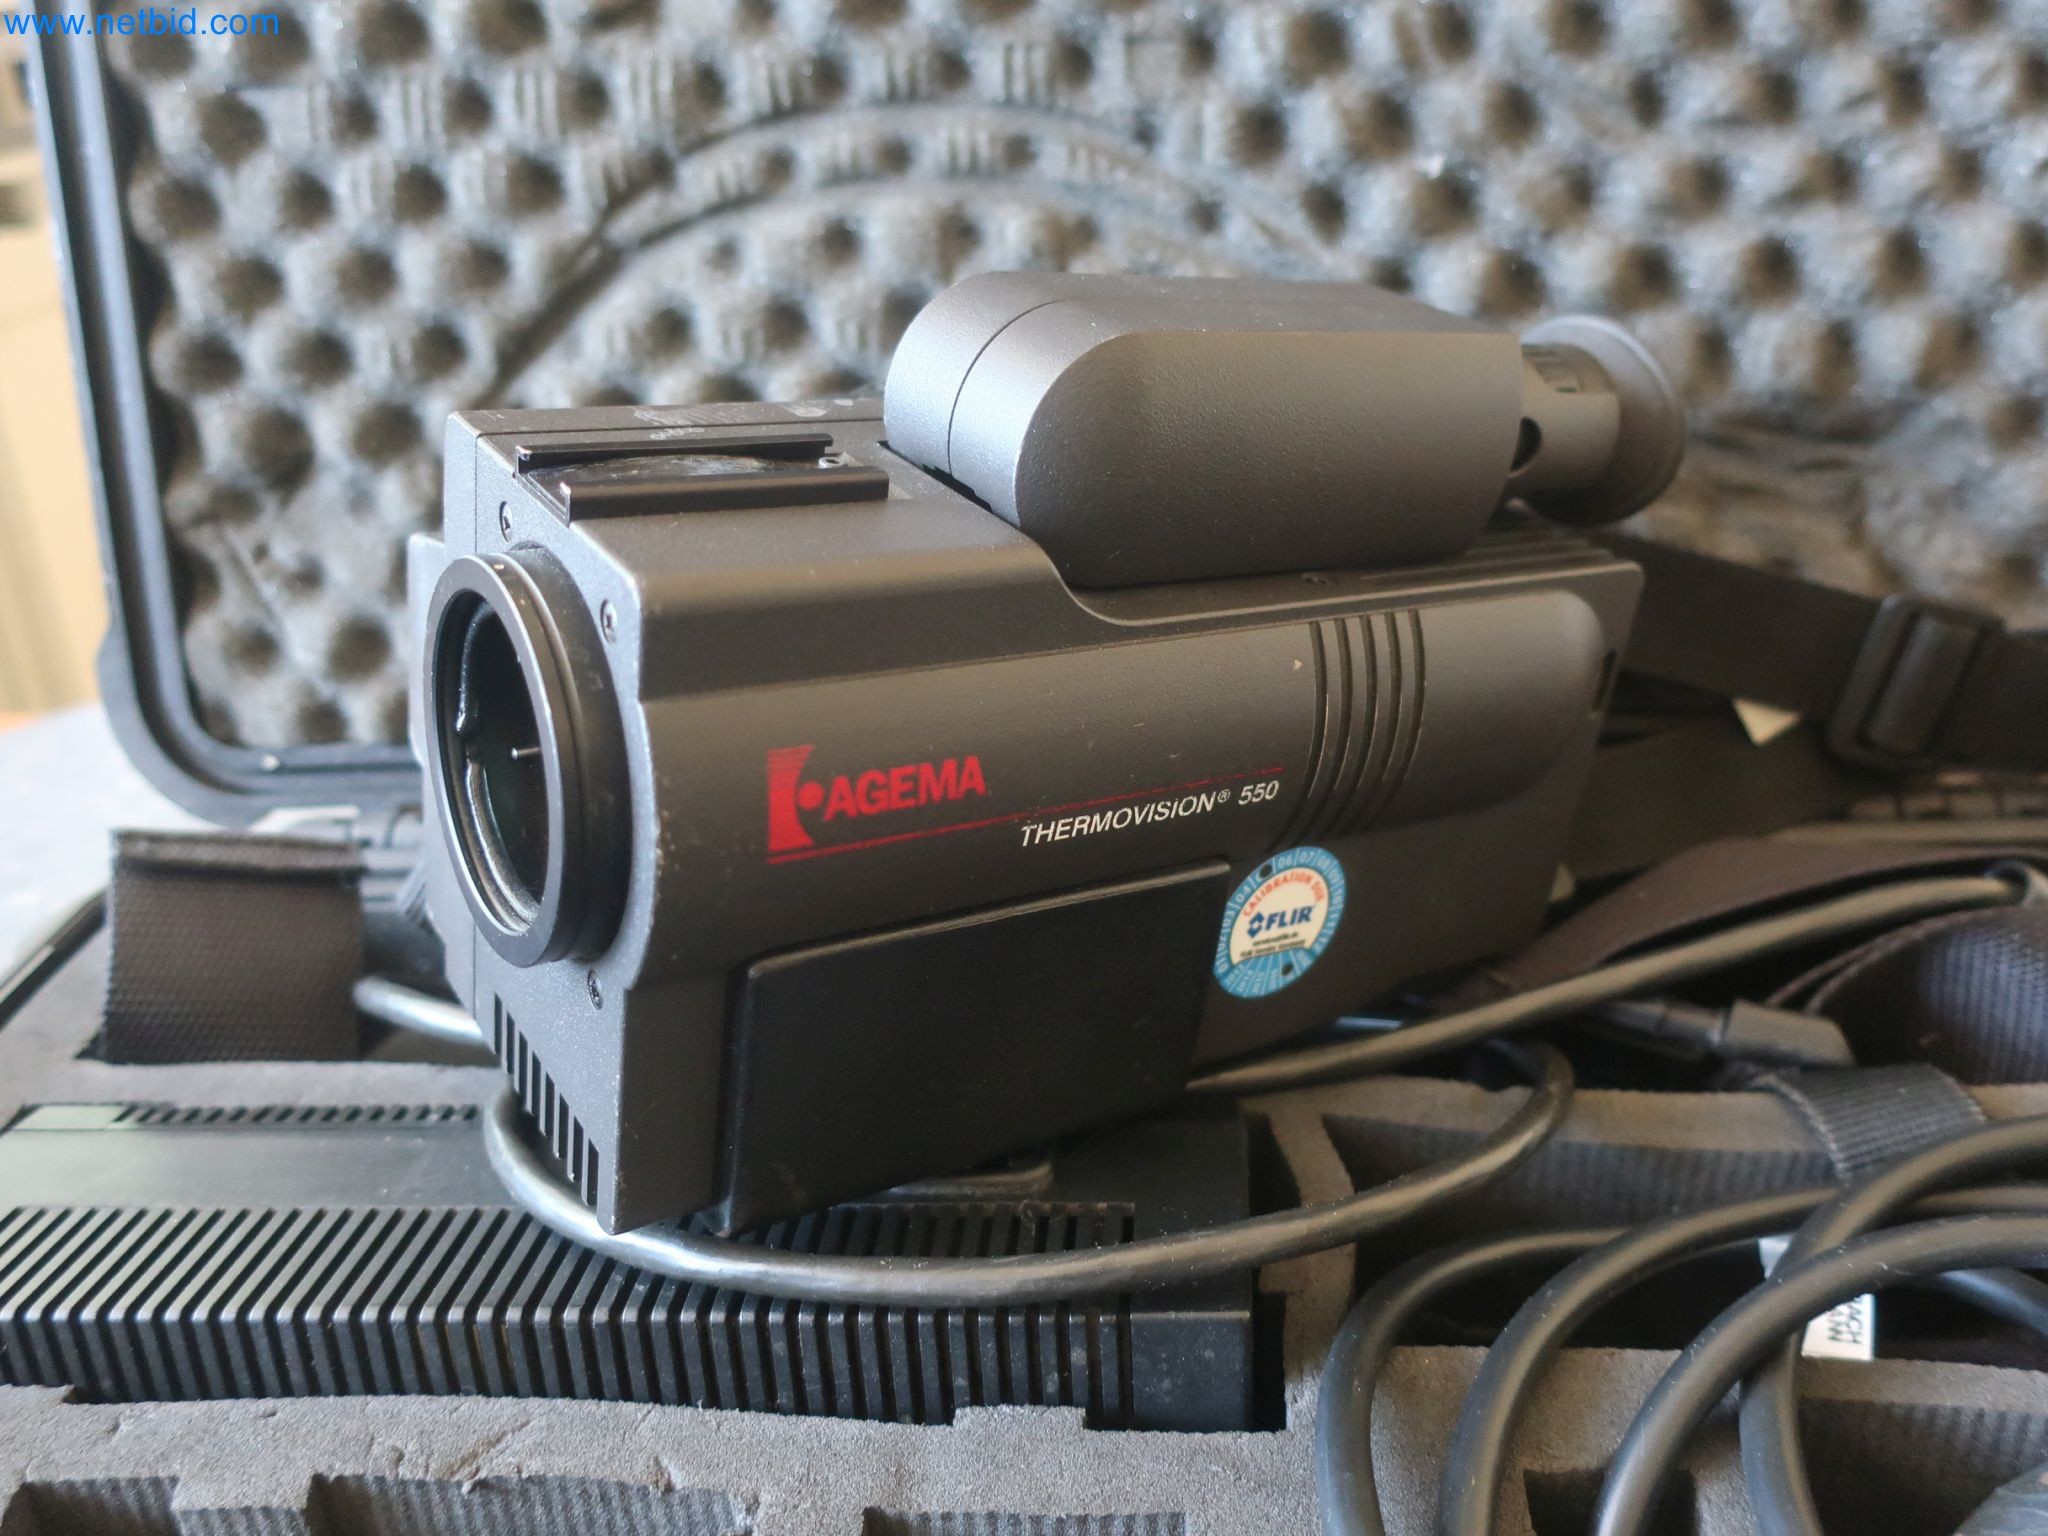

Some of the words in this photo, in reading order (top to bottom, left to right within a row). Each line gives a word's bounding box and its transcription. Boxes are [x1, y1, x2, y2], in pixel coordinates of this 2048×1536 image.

[823, 756, 988, 821] AGEMA
[1238, 780, 1280, 806] 550
[1265, 905, 1313, 931] FLIR
